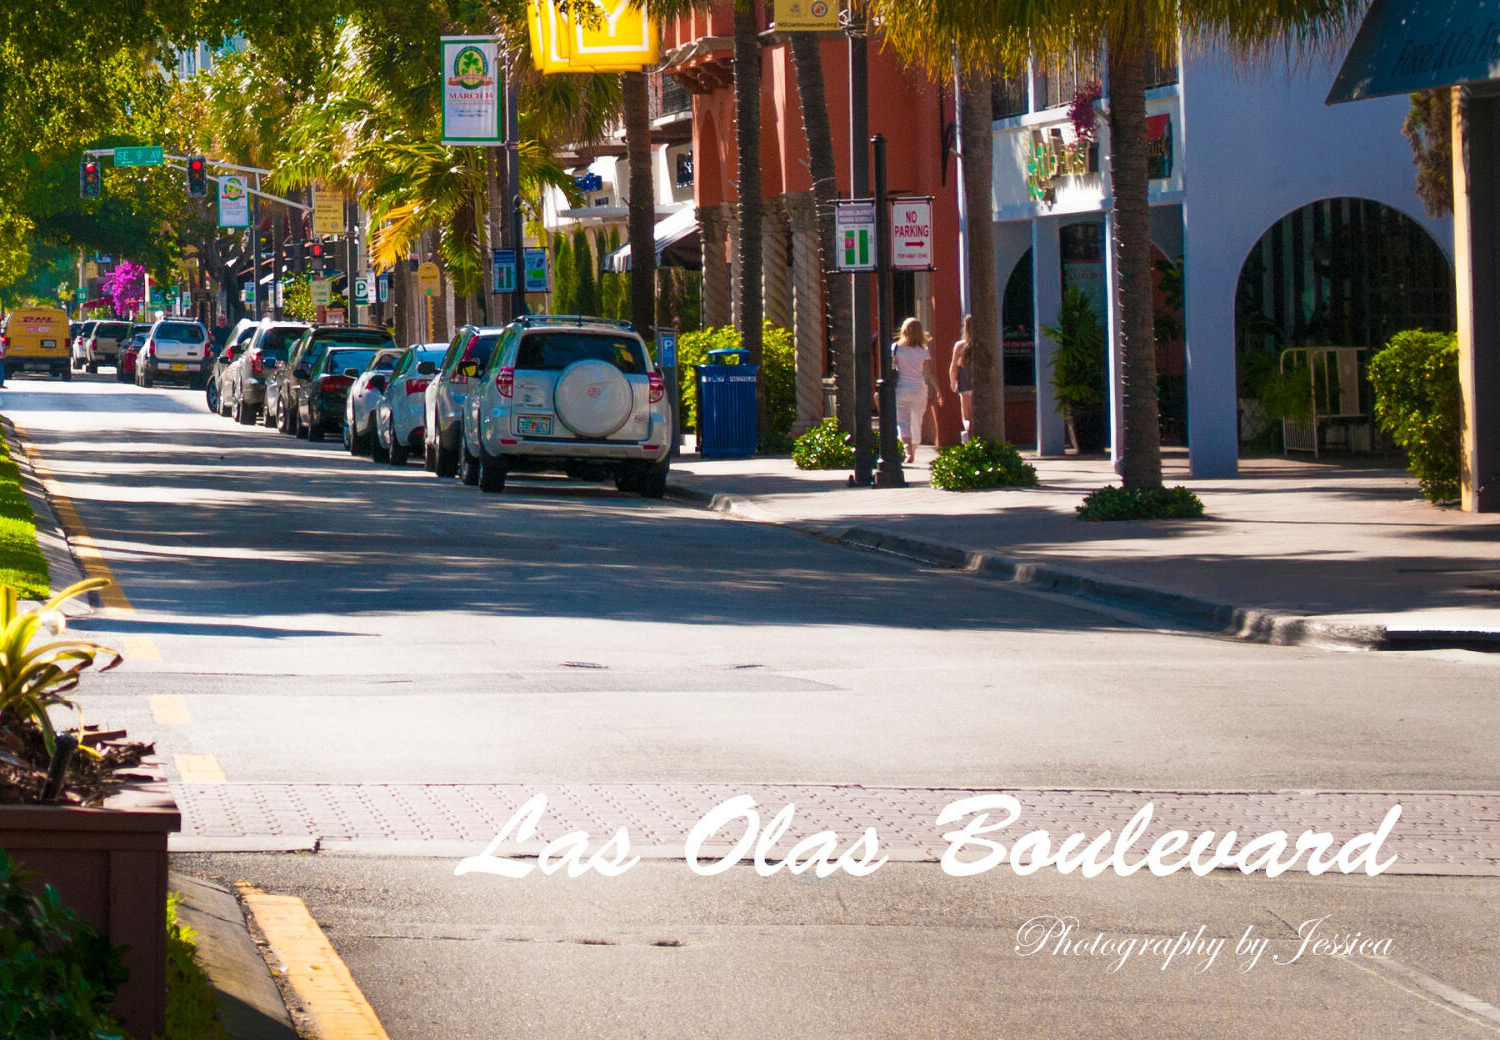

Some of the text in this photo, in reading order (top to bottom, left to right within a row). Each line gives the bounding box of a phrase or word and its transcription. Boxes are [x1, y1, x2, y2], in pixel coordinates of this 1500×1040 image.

[449, 92, 483, 100] MARCH
[116, 148, 161, 161] SE 9 AV
[905, 210, 917, 223] NO
[894, 225, 929, 238] PARKING
[357, 282, 366, 294] P
[22, 316, 53, 324] DHL
[664, 340, 673, 351] P
